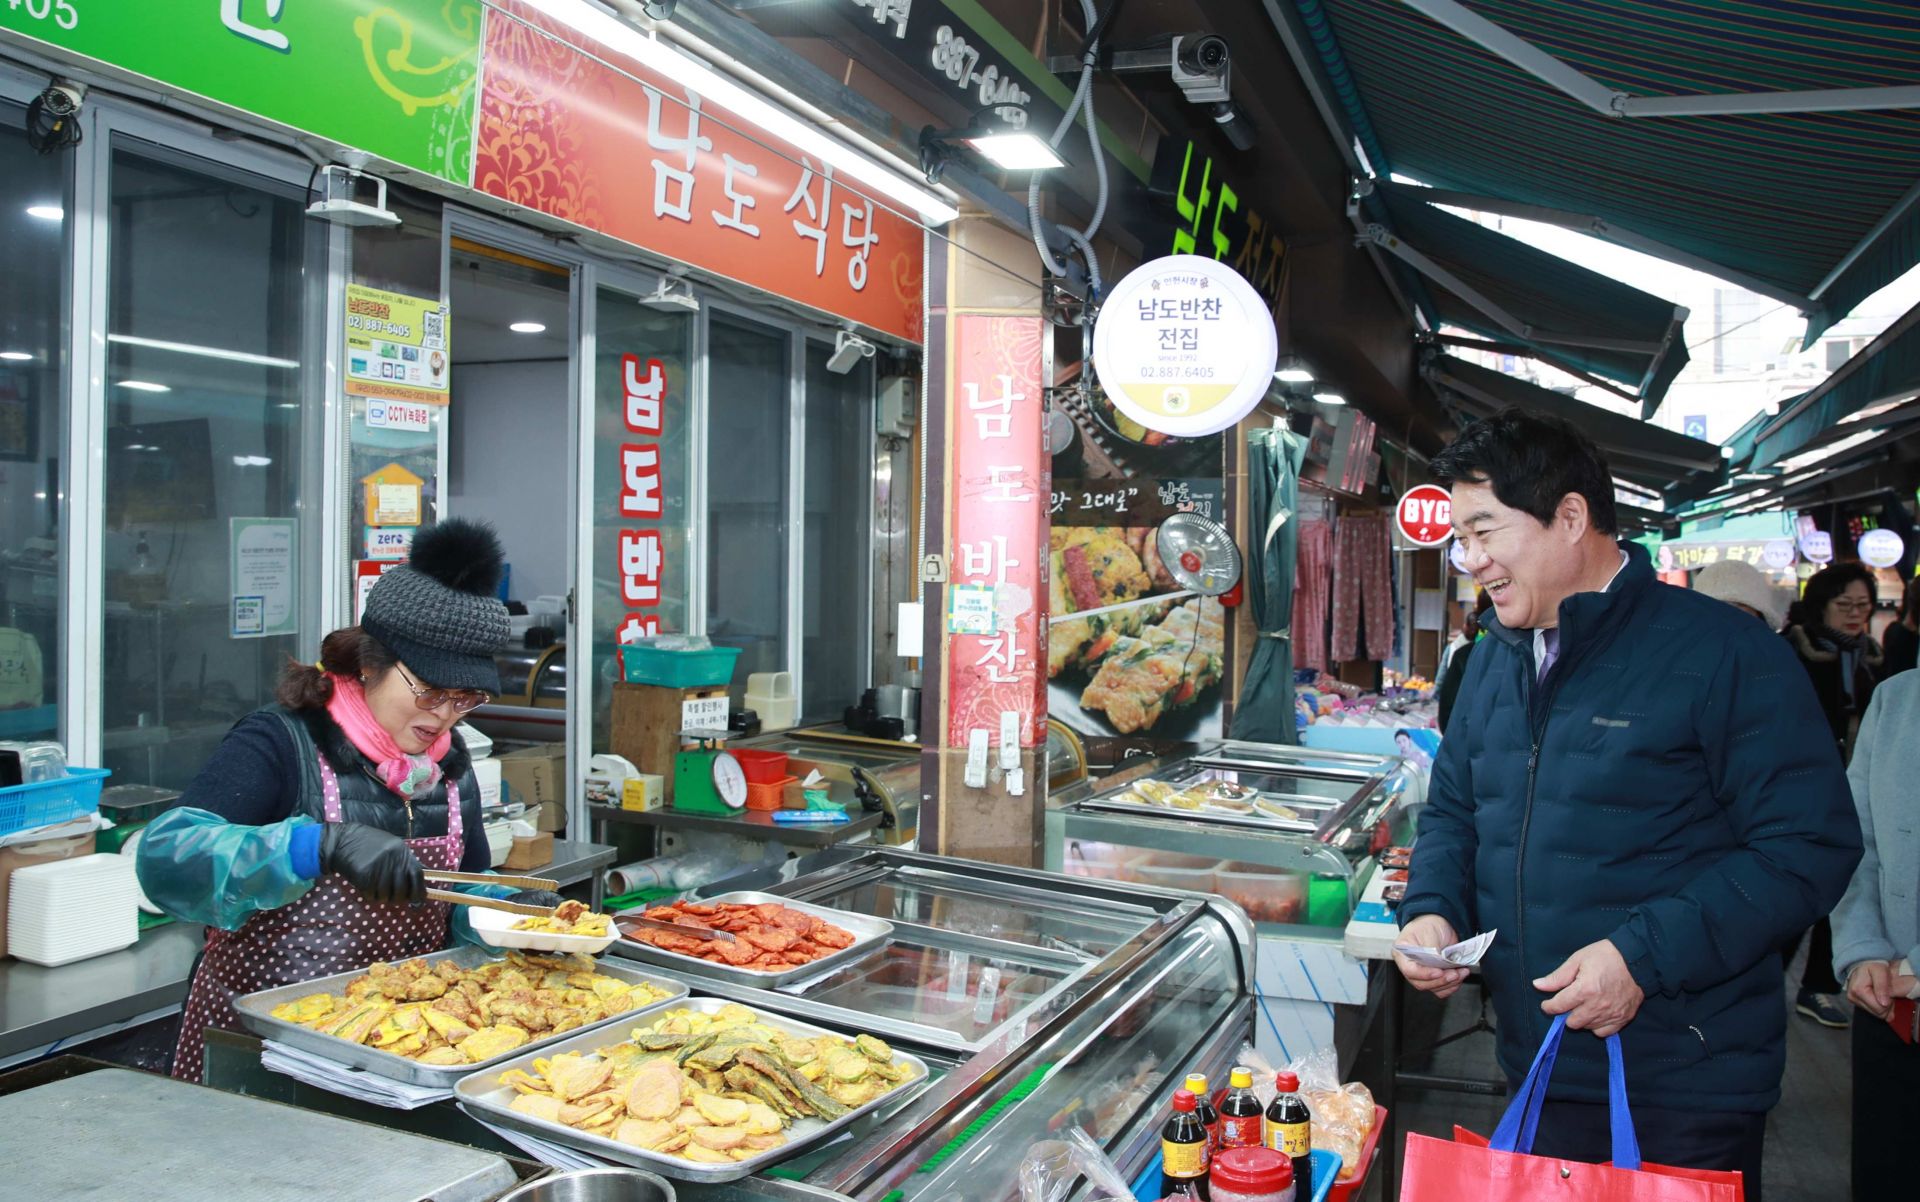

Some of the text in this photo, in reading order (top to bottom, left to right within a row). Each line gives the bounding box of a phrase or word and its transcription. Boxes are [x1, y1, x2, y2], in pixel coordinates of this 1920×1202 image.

[932, 25, 1031, 130] 887-6405
[348, 296, 391, 320] 남도반찬
[1138, 297, 1223, 321] 남도반찬
[348, 315, 411, 338] 02) 887-6405
[1158, 327, 1198, 350] 전집
[1141, 366, 1215, 378] 02.887.6405
[1404, 498, 1451, 525] BYC
[378, 534, 403, 545] zero
